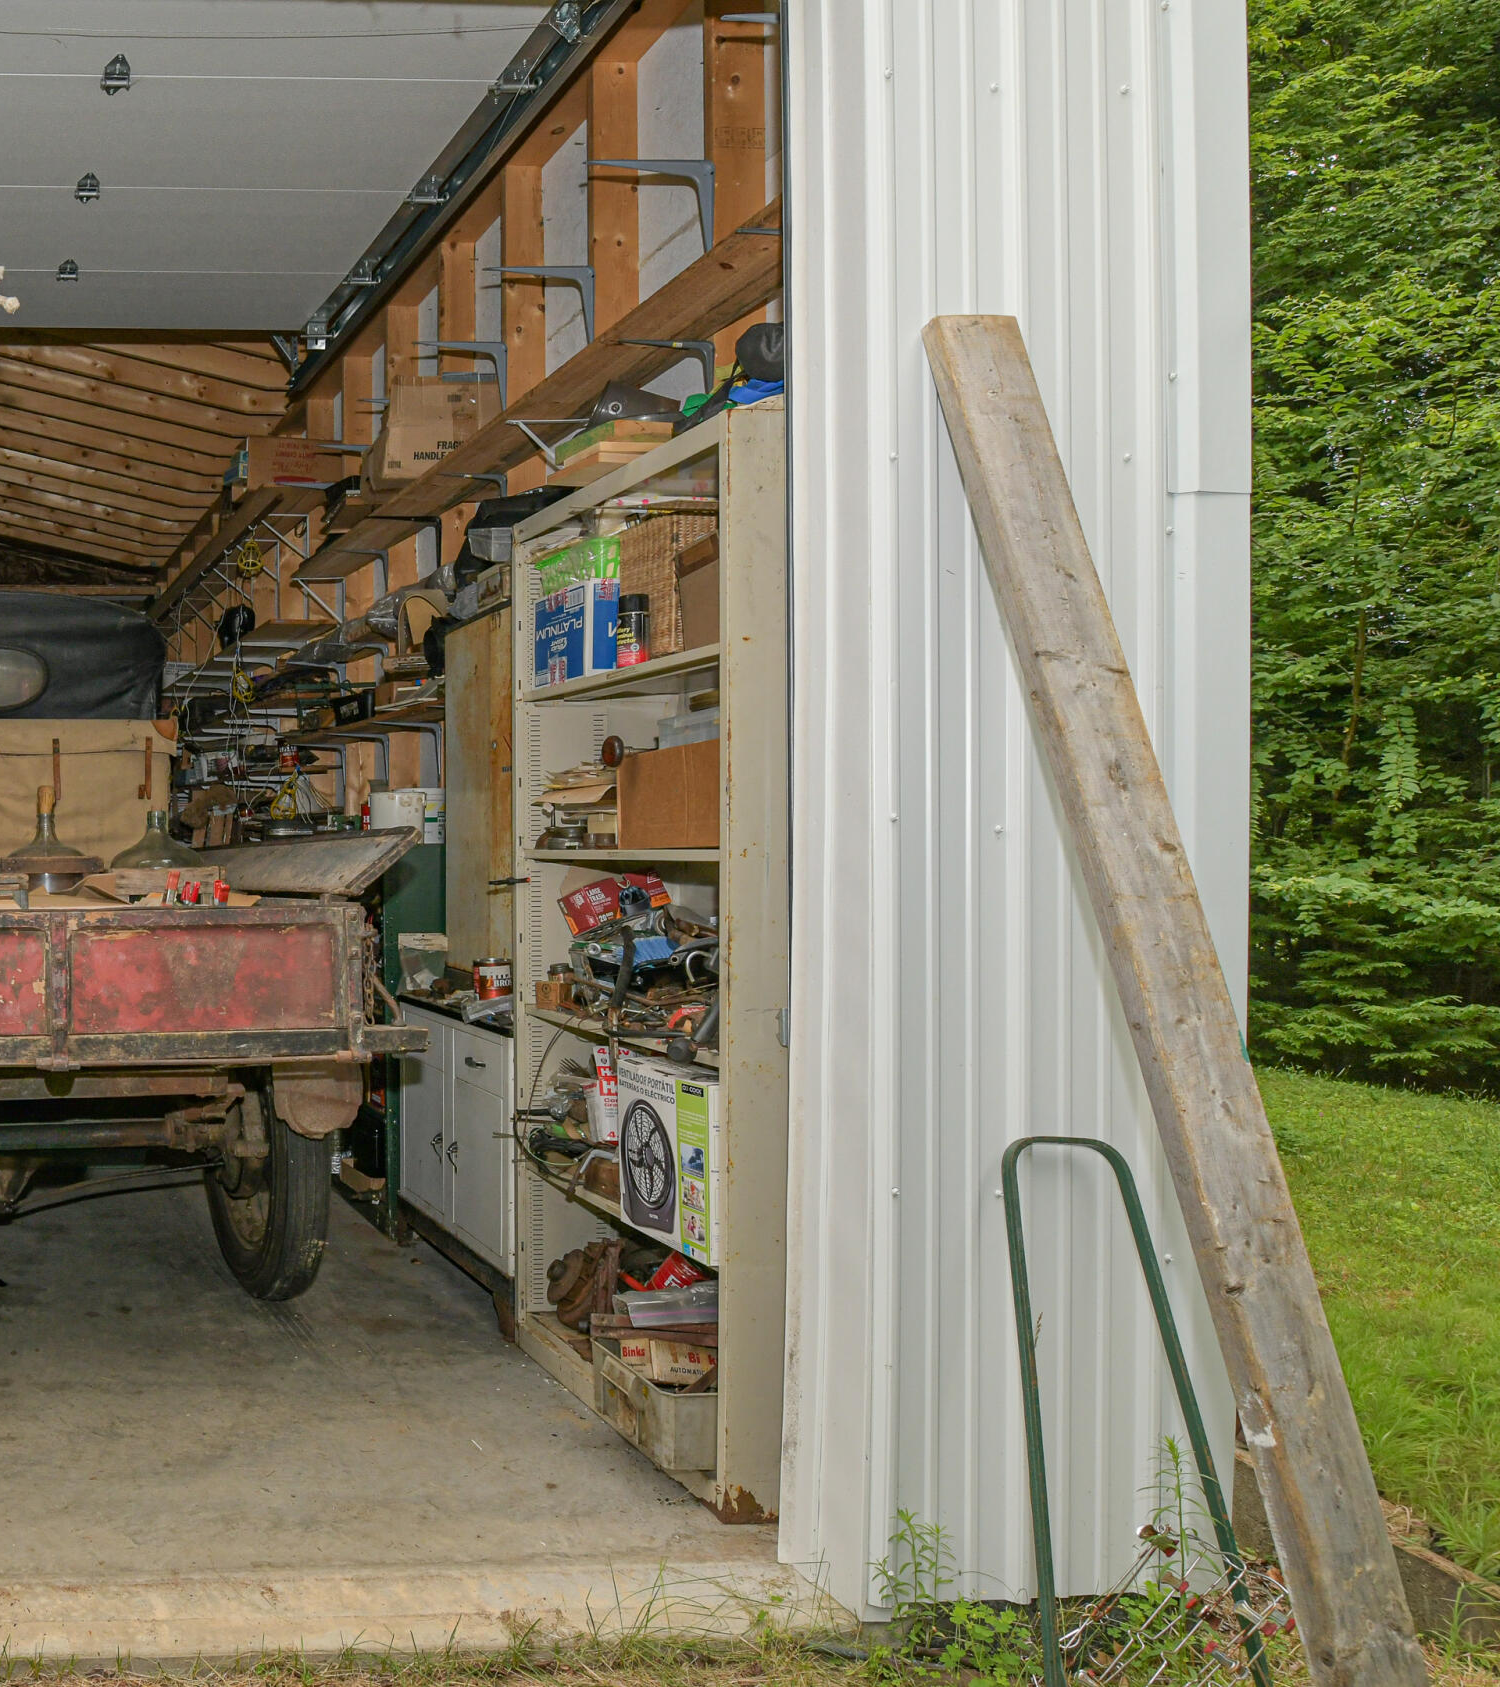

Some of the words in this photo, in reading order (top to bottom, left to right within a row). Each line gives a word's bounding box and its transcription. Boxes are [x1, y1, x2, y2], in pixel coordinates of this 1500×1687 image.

[437, 441, 465, 450] FRAG
[536, 616, 583, 641] PLATINUM
[622, 1346, 645, 1357] Binks
